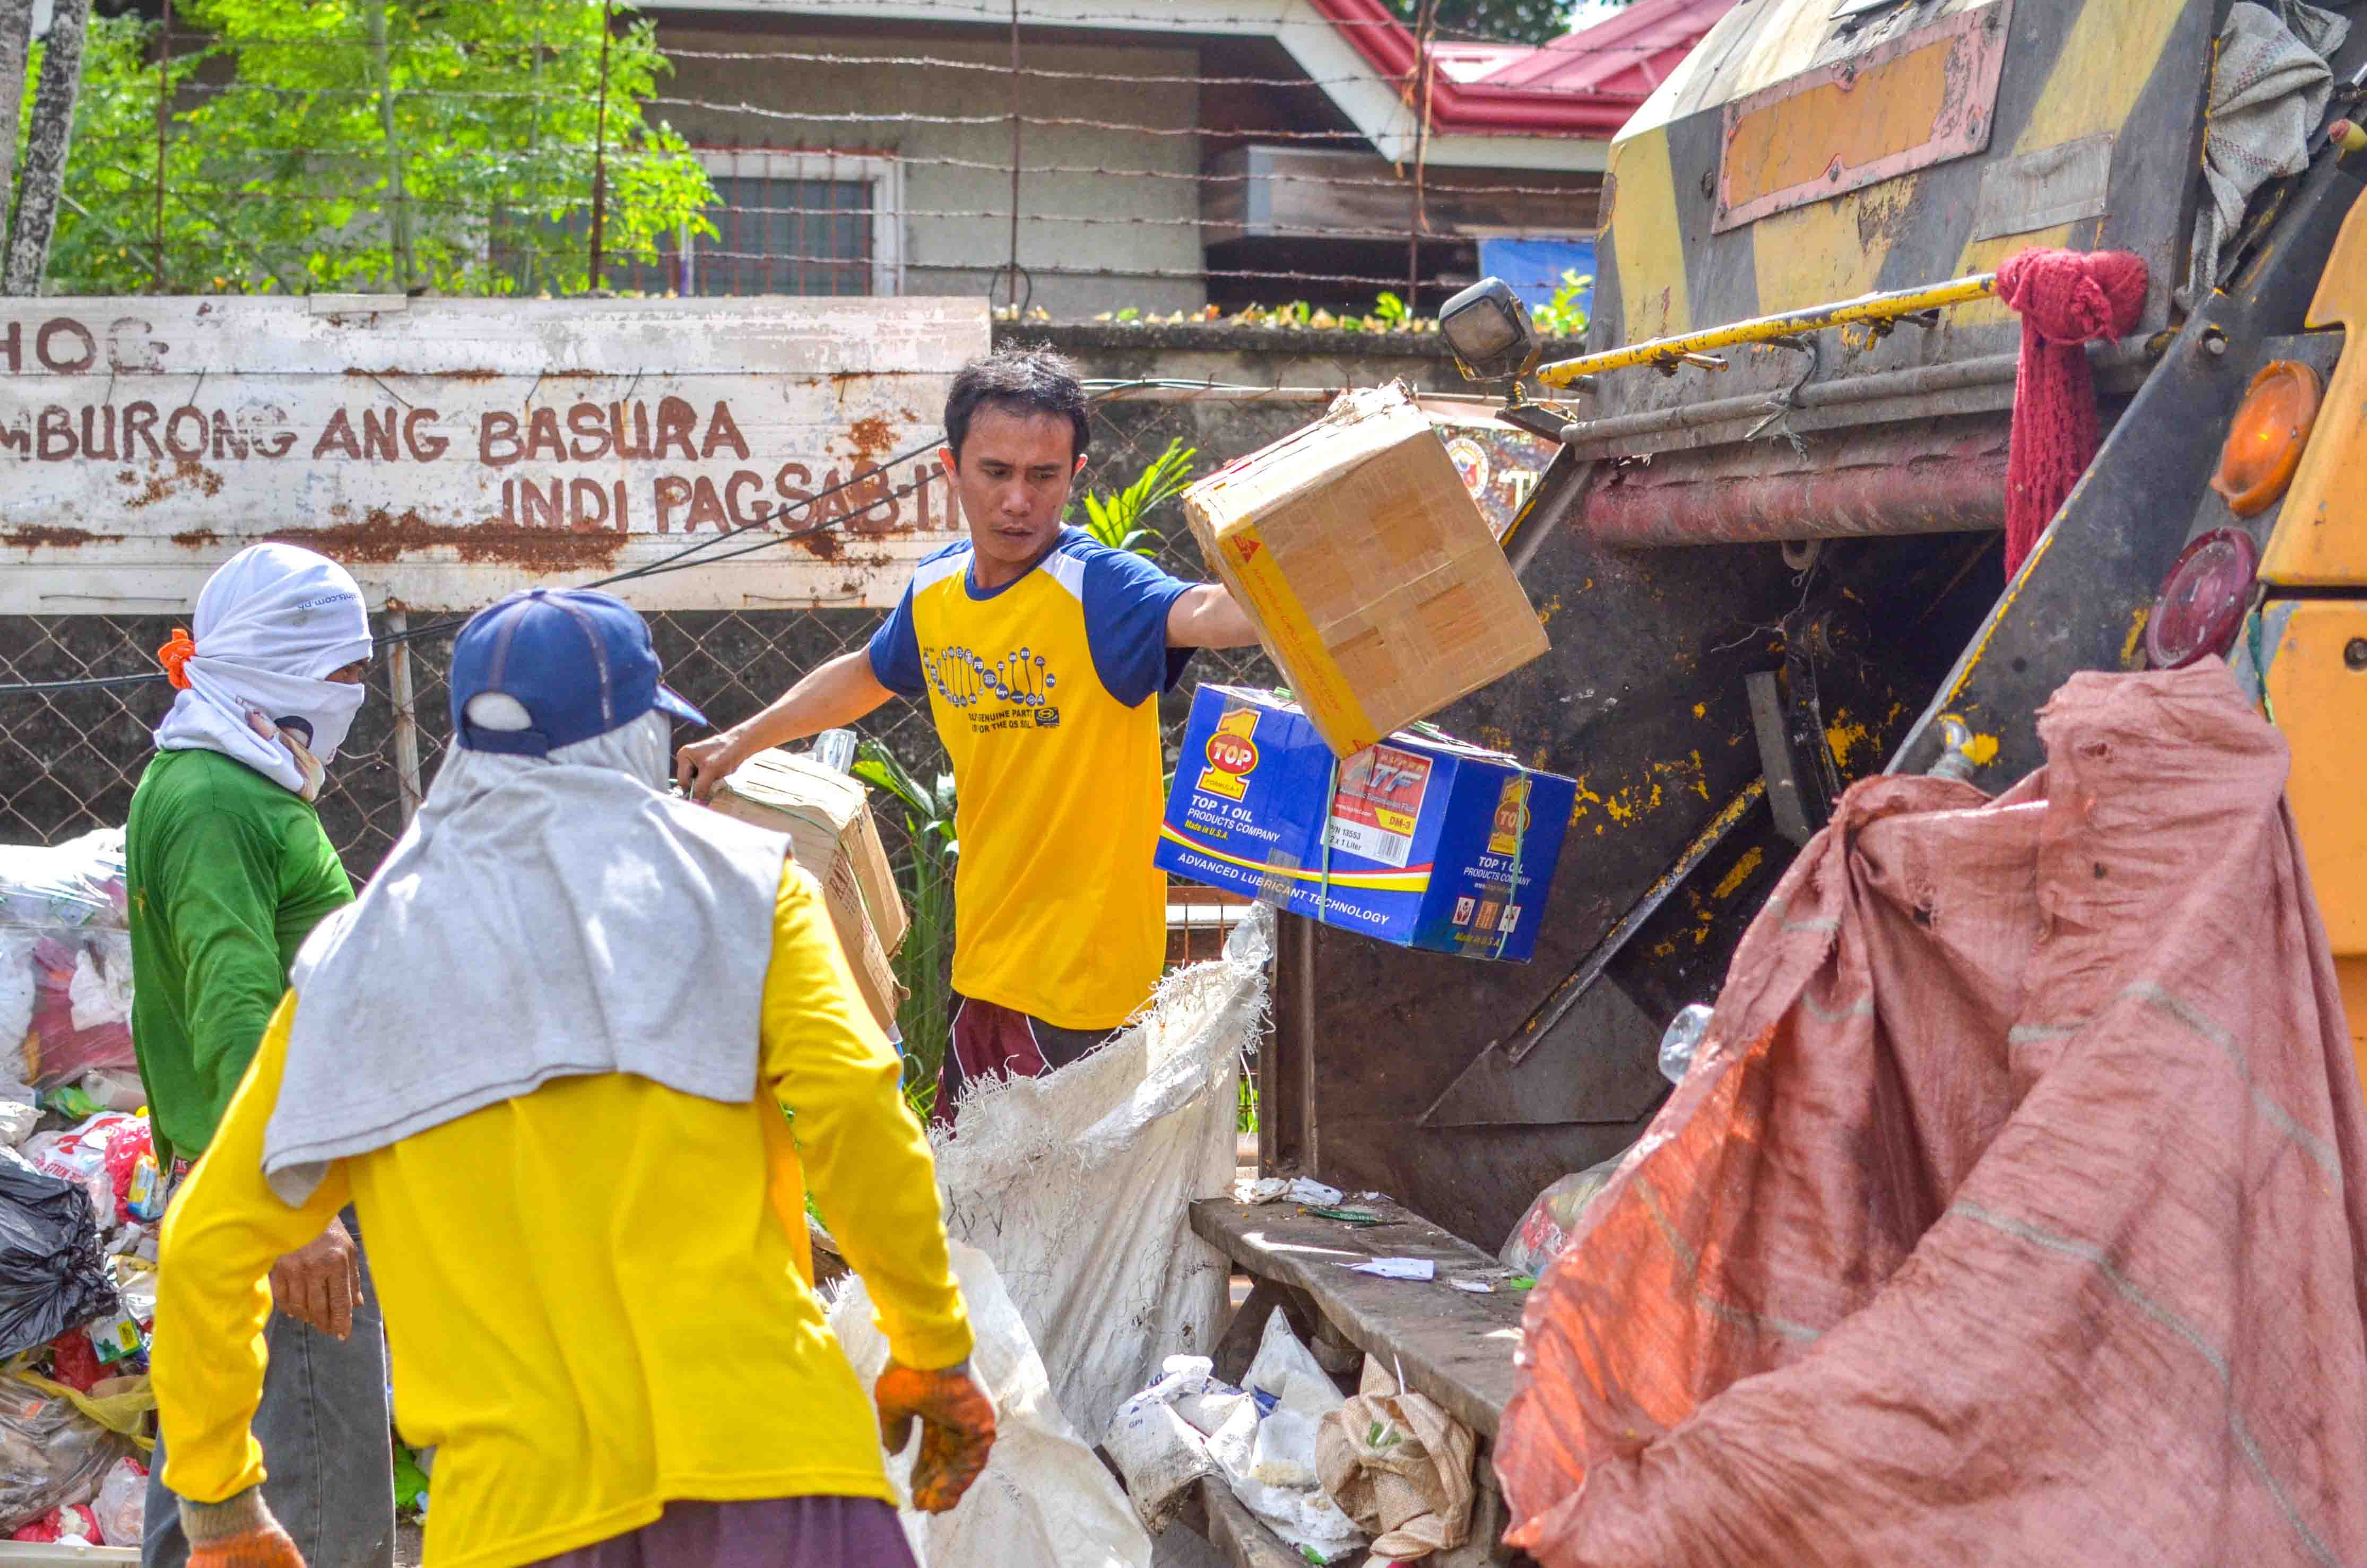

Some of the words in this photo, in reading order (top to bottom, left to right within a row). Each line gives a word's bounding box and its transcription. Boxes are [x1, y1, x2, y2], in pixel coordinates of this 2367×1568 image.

[313, 406, 450, 462] ANG
[479, 395, 750, 466] BASURA
[502, 478, 628, 532] INDI
[1213, 741, 1252, 766] TOP
[1191, 794, 1218, 811] TOP
[1221, 803, 1229, 815] 1
[1232, 807, 1252, 823] OIL
[1184, 819, 1202, 831] Made
[1187, 807, 1236, 829] PRODUCTS
[1235, 822, 1281, 843] COMPANY
[1389, 816, 1412, 830] DM-3
[1342, 828, 1362, 841] 13553
[1346, 840, 1362, 851] Liter
[1478, 855, 1499, 869] TOP
[1501, 860, 1507, 871] 1
[1463, 866, 1501, 881] PRODUCTS
[1177, 852, 1239, 879] ADVANCED
[1240, 871, 1308, 901] LUBRICANT
[1308, 893, 1390, 925] TECHNOLOGY
